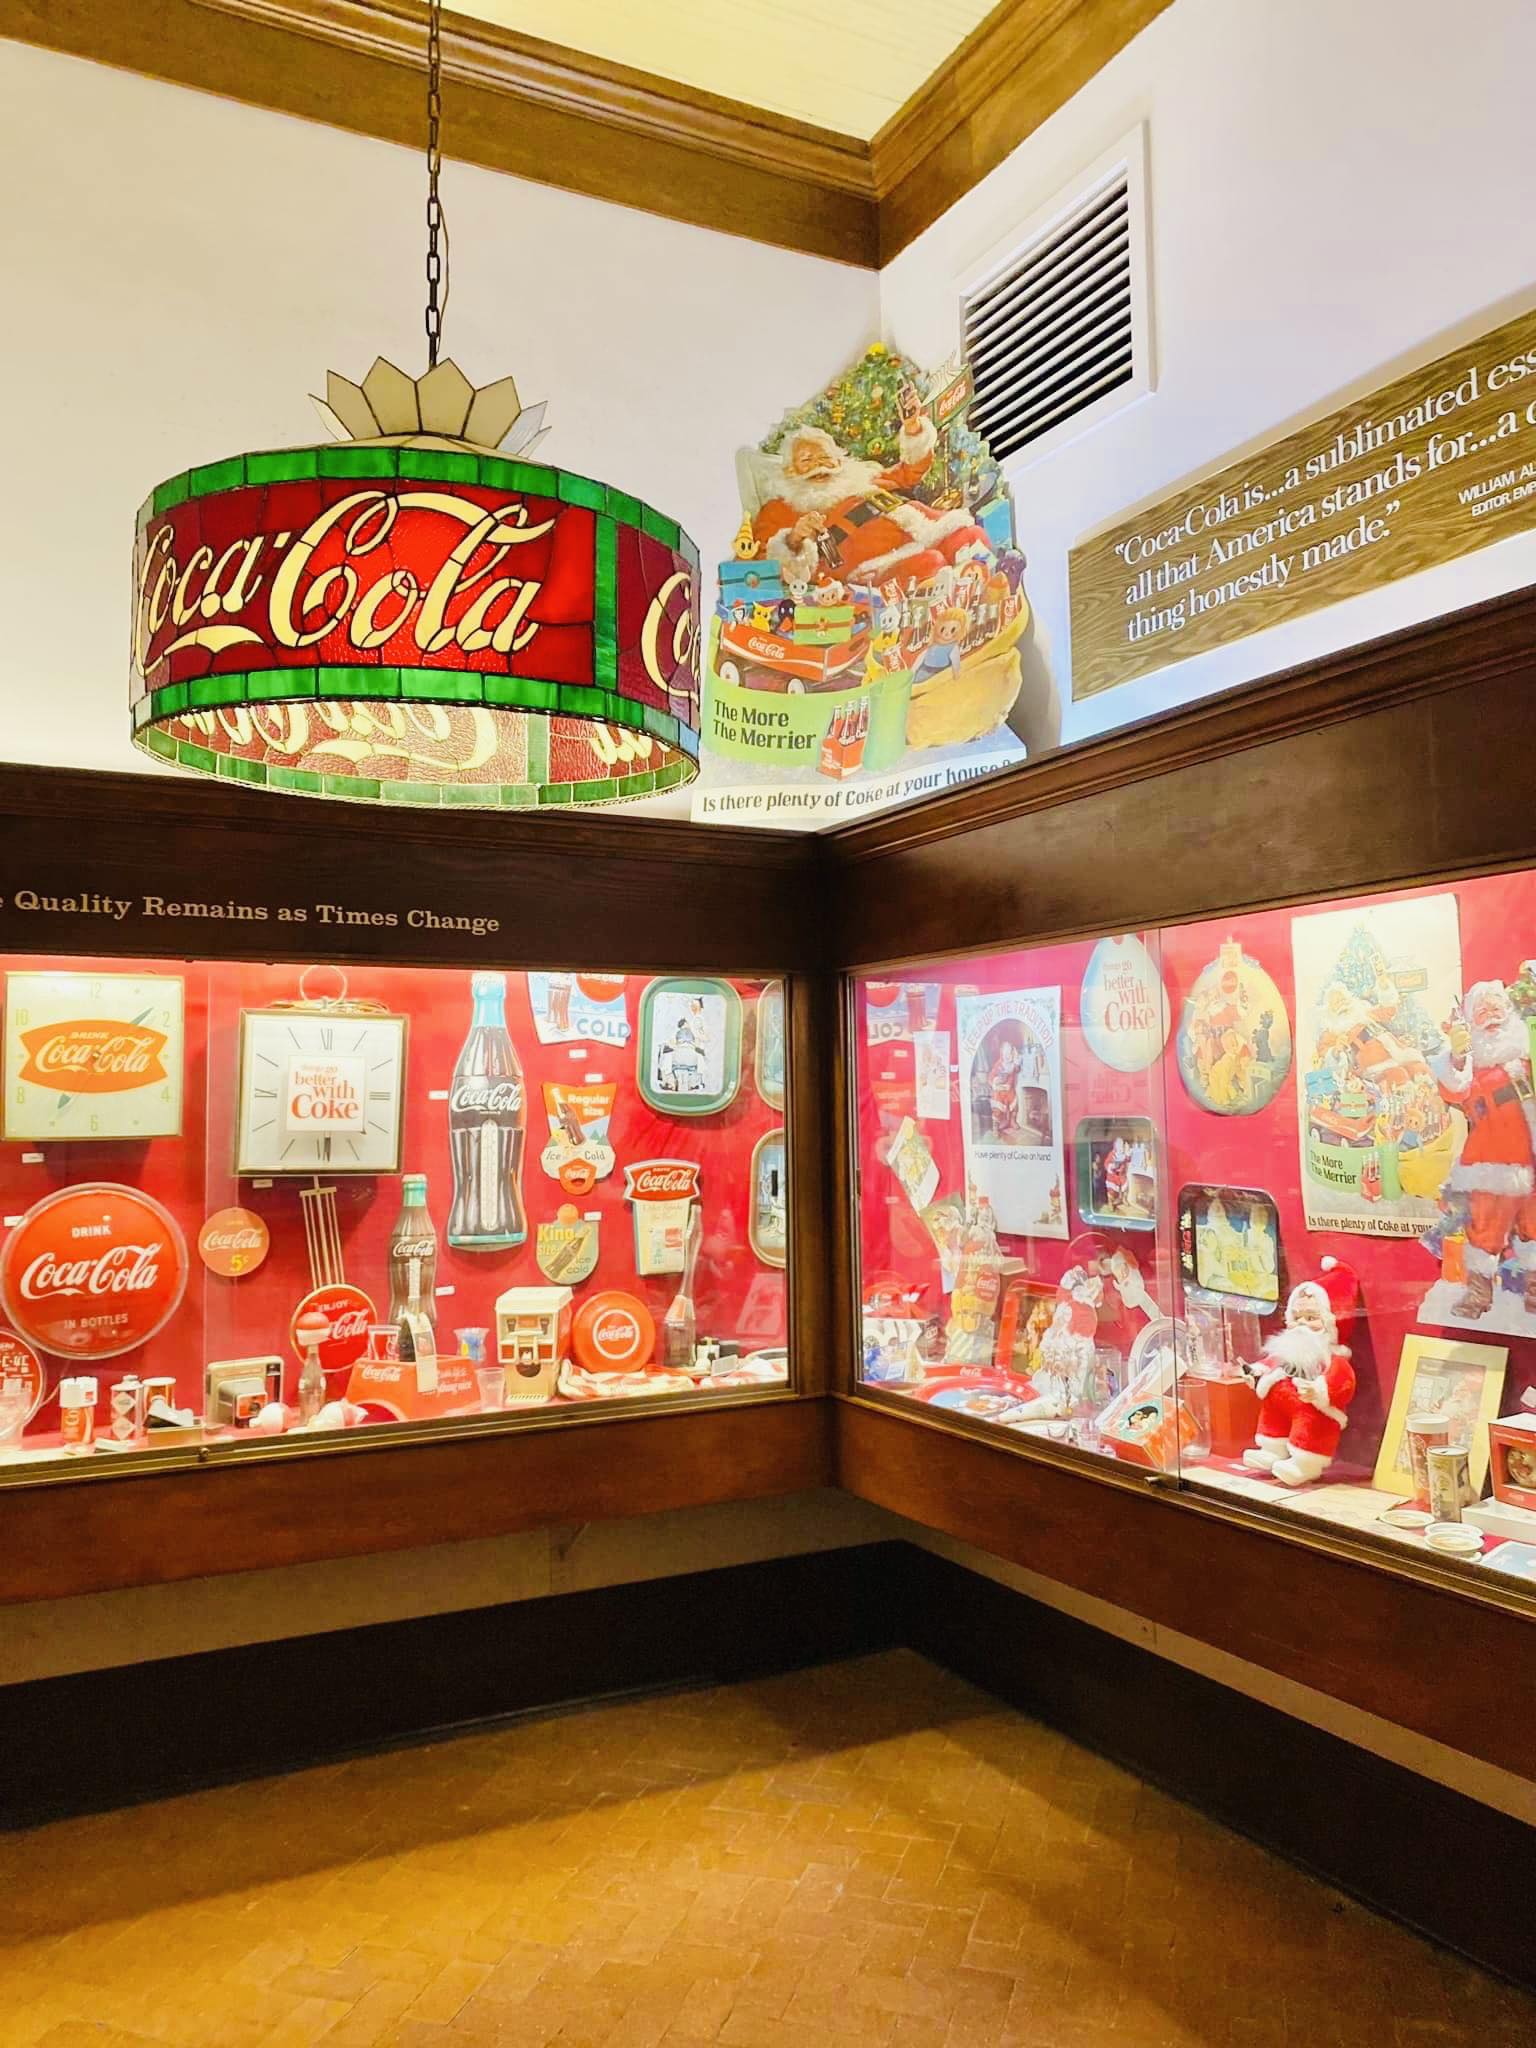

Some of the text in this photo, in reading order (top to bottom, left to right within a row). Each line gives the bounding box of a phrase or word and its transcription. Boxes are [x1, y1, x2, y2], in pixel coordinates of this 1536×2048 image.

[1305, 367, 1481, 481] sublimated
[1458, 470, 1516, 505] WILLIAM
[1125, 570, 1153, 606] all
[1156, 552, 1200, 592] that
[1205, 504, 1317, 571] America
[1321, 452, 1422, 519] stands
[1127, 599, 1186, 642] thing
[1189, 552, 1294, 618] honestly
[714, 699, 790, 728] The More
[713, 719, 817, 750] The Merrier
[703, 797, 717, 812] Is
[720, 794, 763, 811] there
[766, 791, 821, 812] plenty
[824, 789, 843, 807] of
[845, 787, 883, 806] Coke
[886, 780, 901, 797] at
[903, 772, 942, 797] your
[14, 890, 133, 920] Quality
[142, 896, 269, 920] Remains
[277, 907, 308, 922] as
[315, 904, 399, 926] Times
[407, 909, 500, 936] Change
[1103, 974, 1134, 992] better
[576, 1018, 631, 1038] COLD
[1104, 1002, 1155, 1033] Coke
[295, 1071, 337, 1085] better
[313, 1080, 355, 1099] with
[291, 1093, 359, 1119] Coke
[546, 1150, 606, 1161] Ice Cold
[1321, 1154, 1344, 1170] More
[1323, 1167, 1357, 1184] Merrier
[71, 1225, 112, 1238] DRINK
[1317, 1216, 1340, 1228] there
[1341, 1217, 1366, 1231] plenty
[1367, 1218, 1376, 1230] of
[1378, 1219, 1399, 1231] Coke
[64, 1313, 129, 1329] IN BOTTLES
